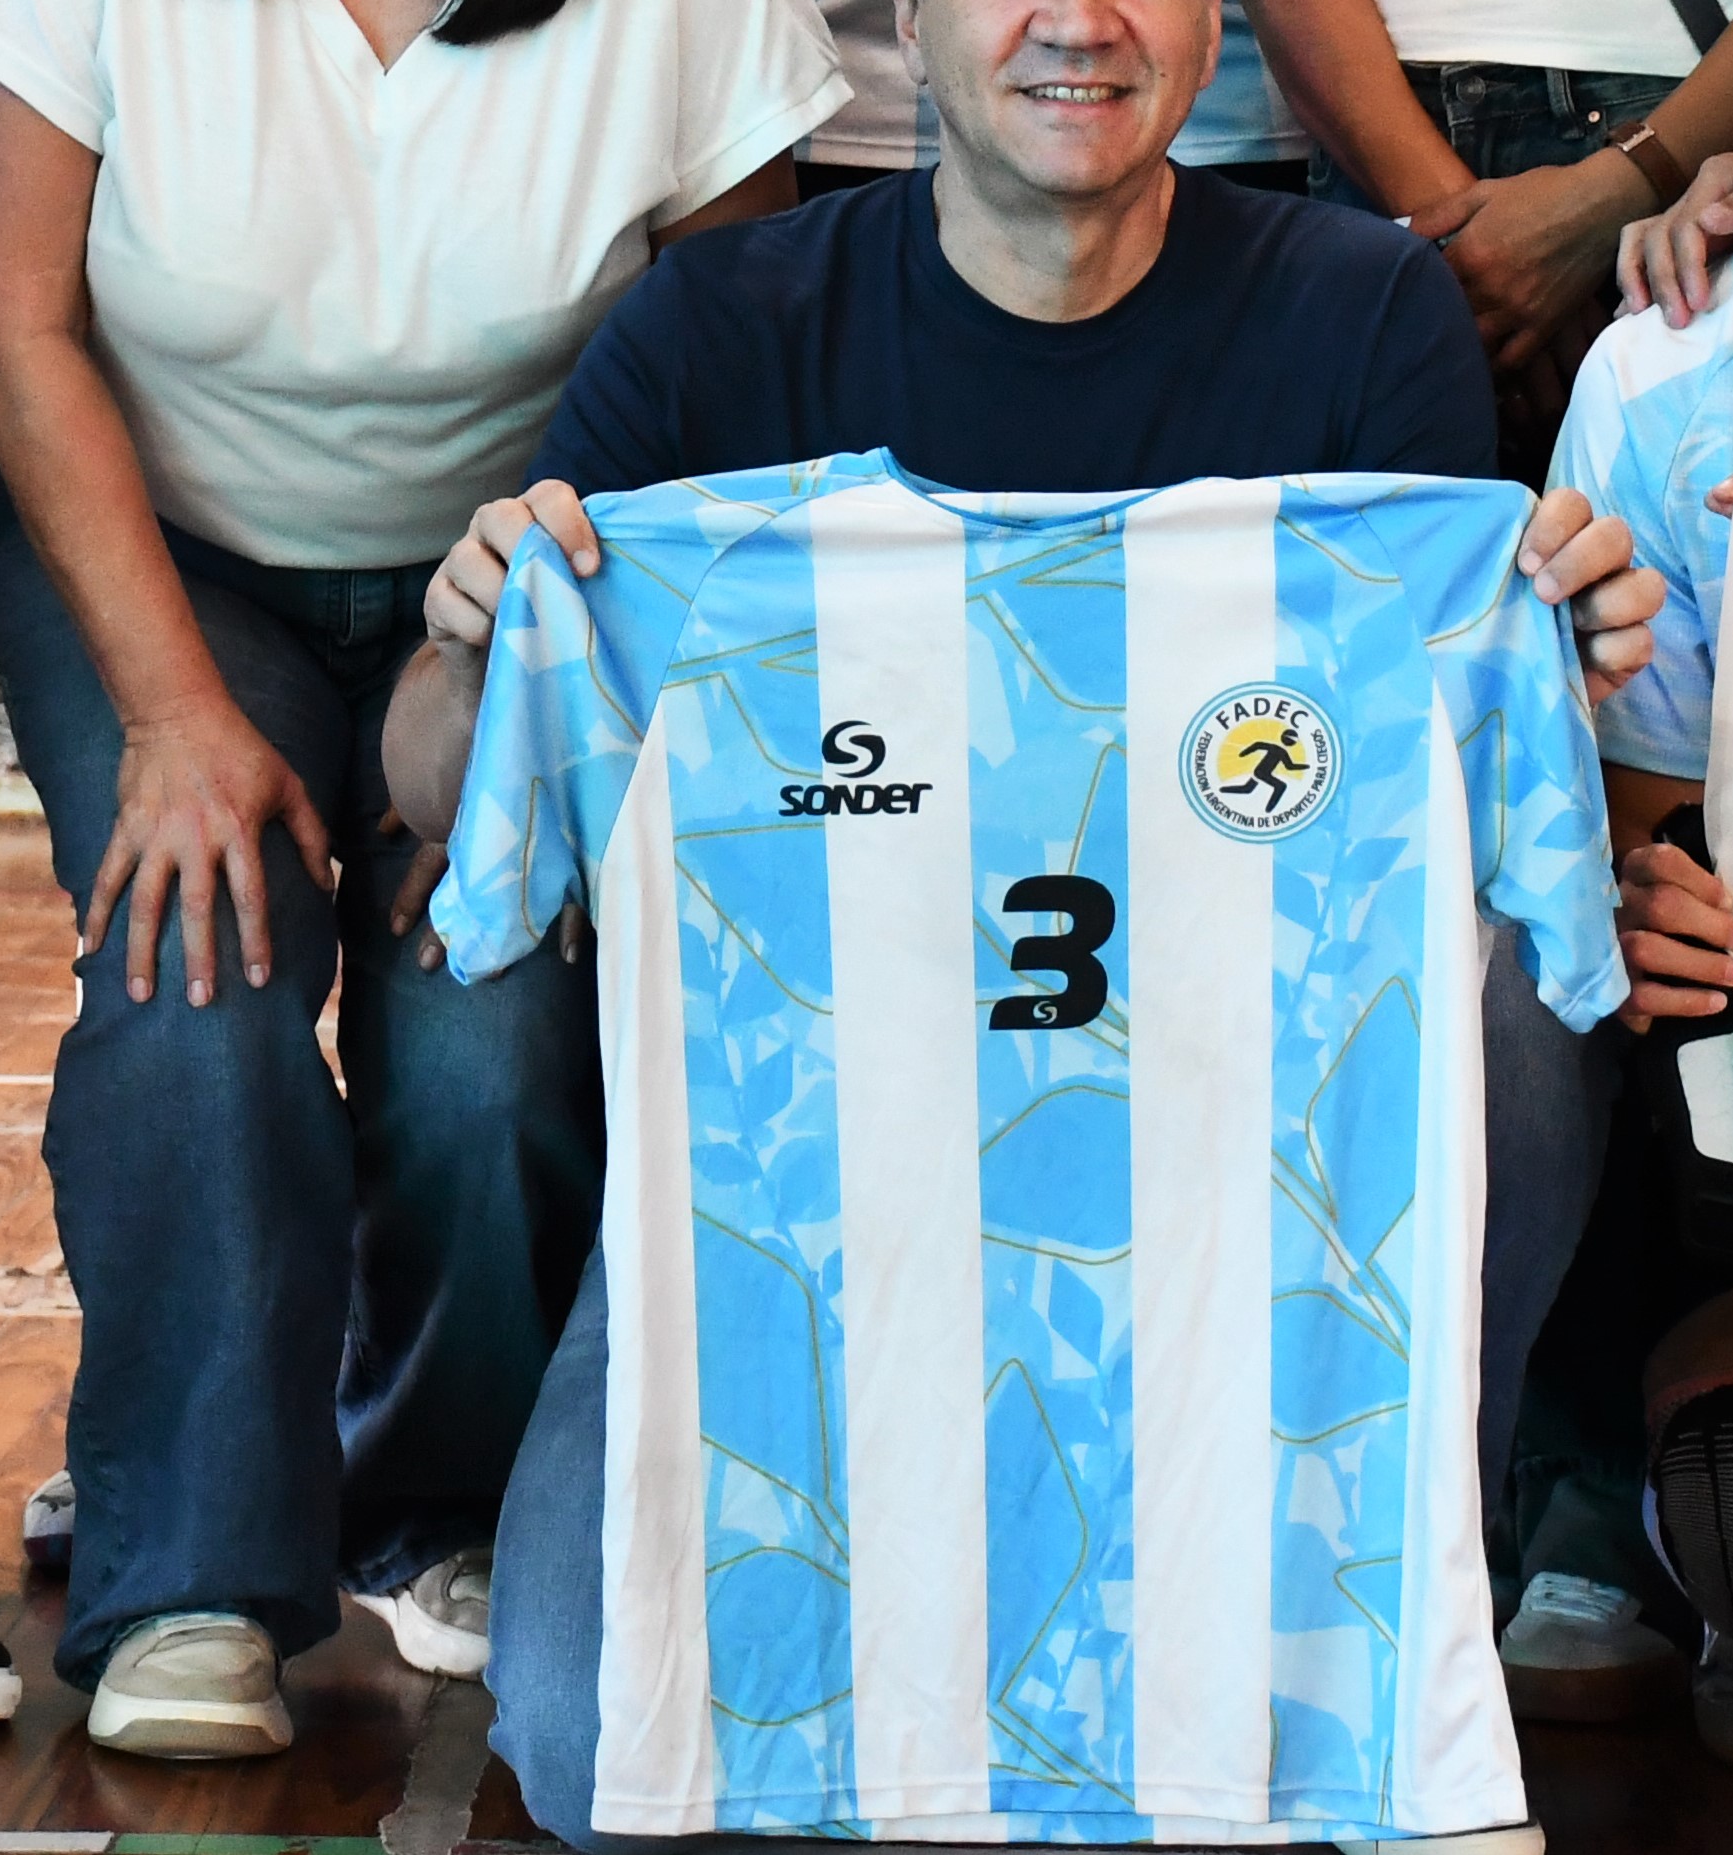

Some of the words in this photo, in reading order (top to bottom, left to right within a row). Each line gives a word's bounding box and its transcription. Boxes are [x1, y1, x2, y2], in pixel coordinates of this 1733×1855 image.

[1215, 697, 1310, 731] FADEC
[1204, 789, 1255, 828] ARGENTINA
[1257, 817, 1271, 828] DE
[1272, 791, 1317, 827] DEPORTES
[1311, 766, 1328, 793] PARA
[988, 873, 1117, 1031] 3
